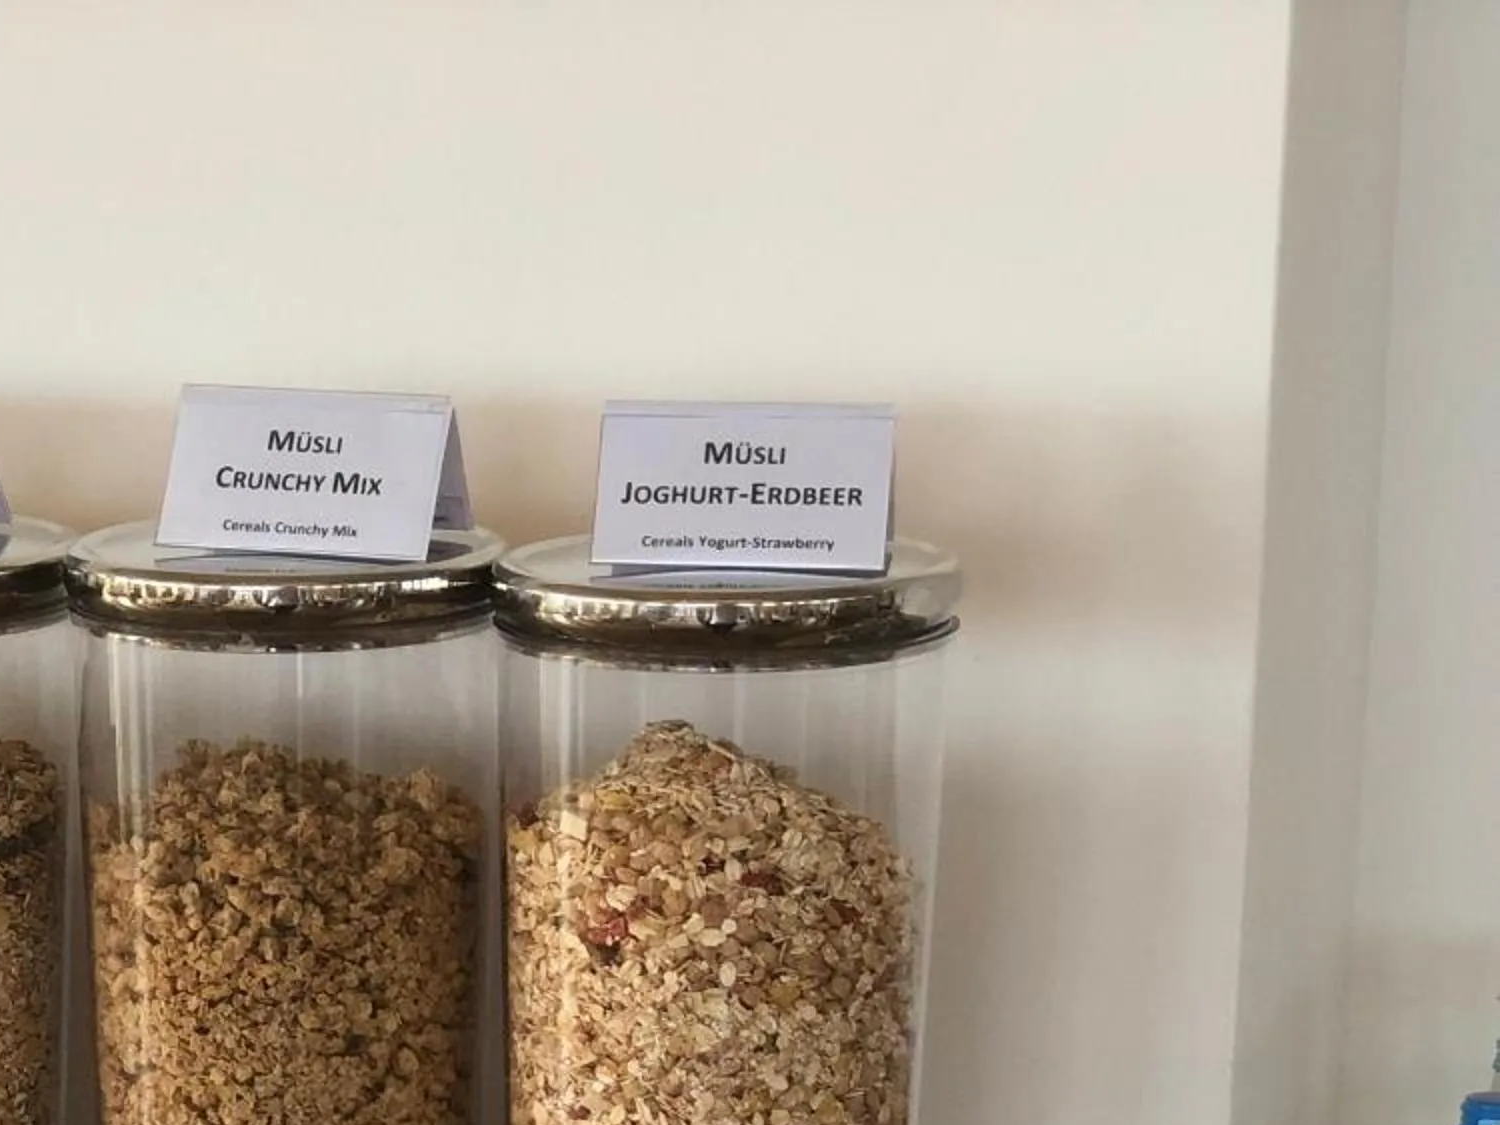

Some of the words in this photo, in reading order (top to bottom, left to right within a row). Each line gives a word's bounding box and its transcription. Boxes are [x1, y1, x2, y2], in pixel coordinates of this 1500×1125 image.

[267, 429, 344, 455] MÜSLI
[703, 439, 787, 465] MÜSLI
[215, 465, 327, 493] CRUNCHY
[331, 471, 383, 497] MIX
[620, 481, 863, 507] JOGHURT-ERDBEER
[222, 518, 270, 533] Cereals
[273, 520, 329, 539] Crunchy
[331, 524, 358, 538] Mix
[640, 535, 695, 549] Cereals
[698, 535, 835, 553] Yogurt-Strawberry
